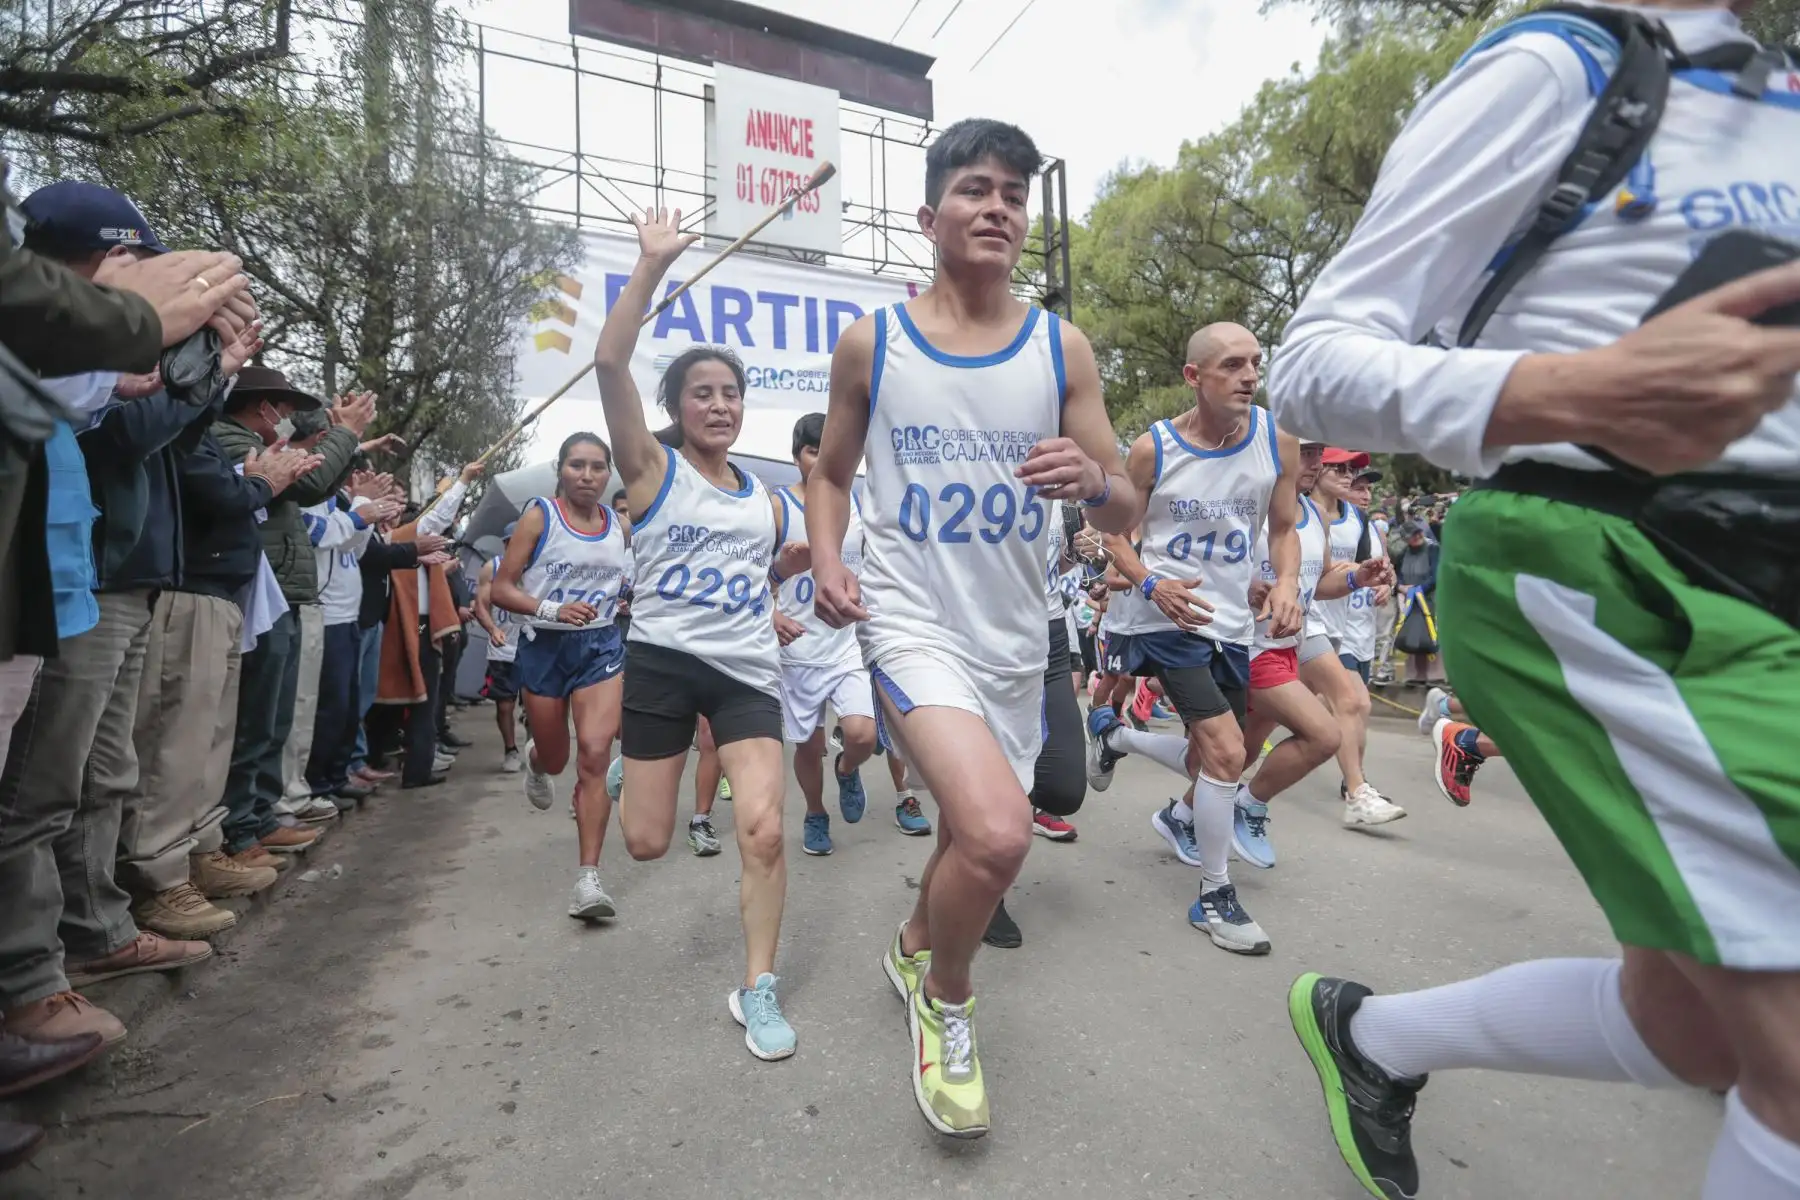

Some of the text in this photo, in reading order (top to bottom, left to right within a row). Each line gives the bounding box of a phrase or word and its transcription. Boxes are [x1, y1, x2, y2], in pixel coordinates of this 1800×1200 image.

[746, 108, 815, 158] ANUNCIE
[746, 366, 794, 390] GRC
[891, 425, 940, 451] GRC
[942, 428, 1000, 443] GOBIERNO
[899, 483, 1044, 543] 0295
[1169, 499, 1199, 515] GRC
[668, 525, 709, 543] GRC
[1167, 529, 1254, 564] 019
[1107, 655, 1122, 671] 14
